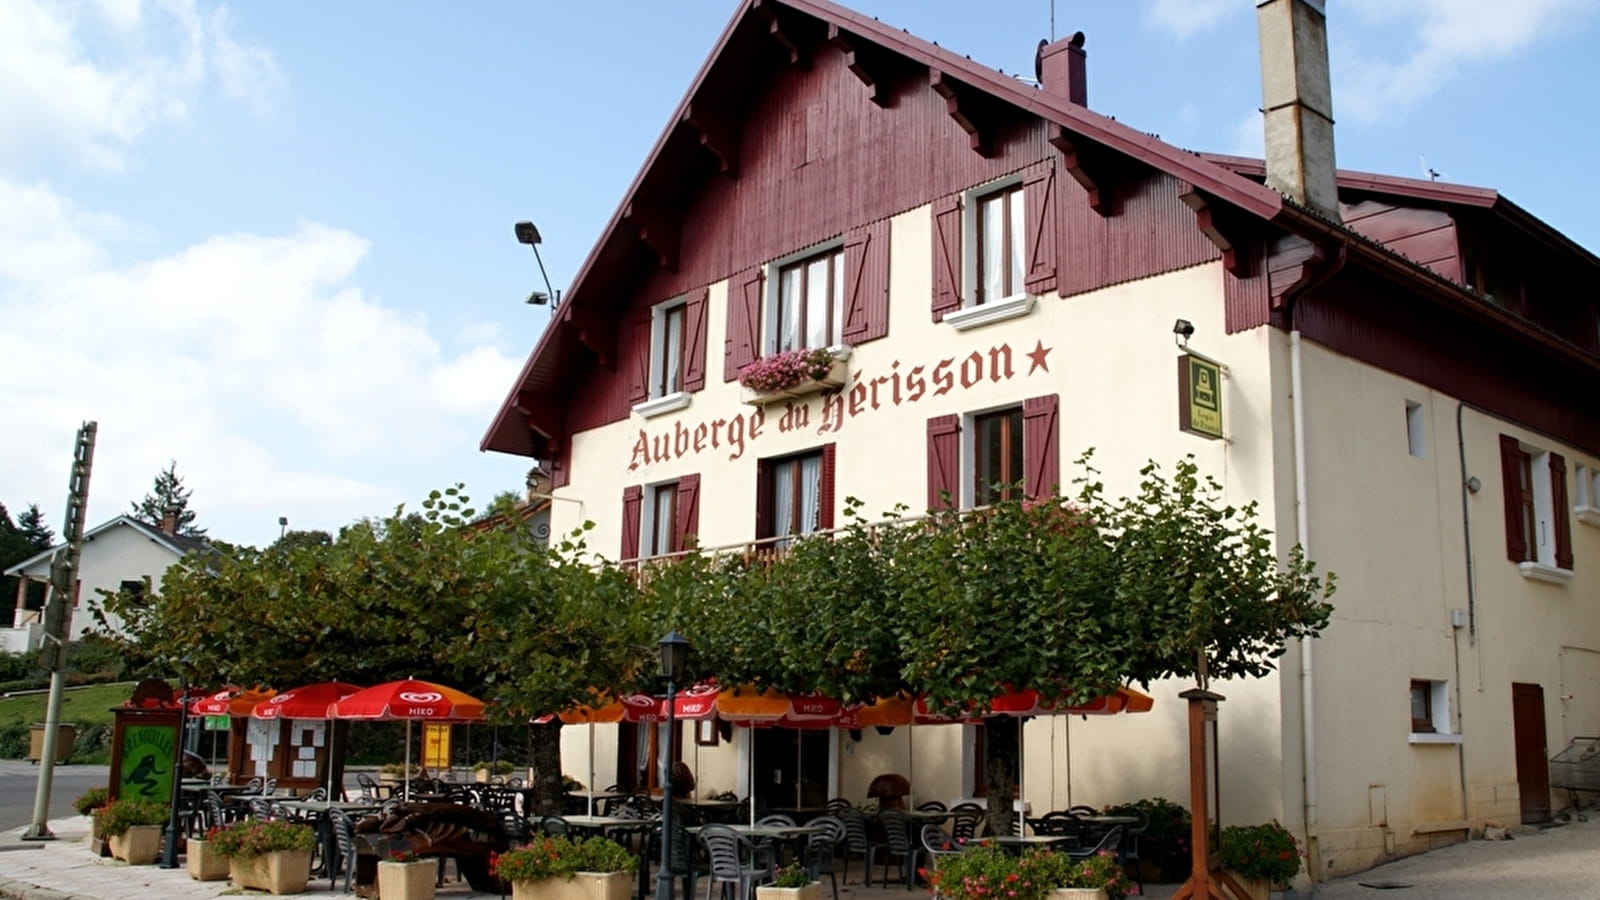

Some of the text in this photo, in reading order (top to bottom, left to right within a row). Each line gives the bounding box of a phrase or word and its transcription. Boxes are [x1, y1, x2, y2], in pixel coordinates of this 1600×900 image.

[627, 342, 1015, 471] Auberge du Hérisson
[408, 707, 434, 716] MIKO
